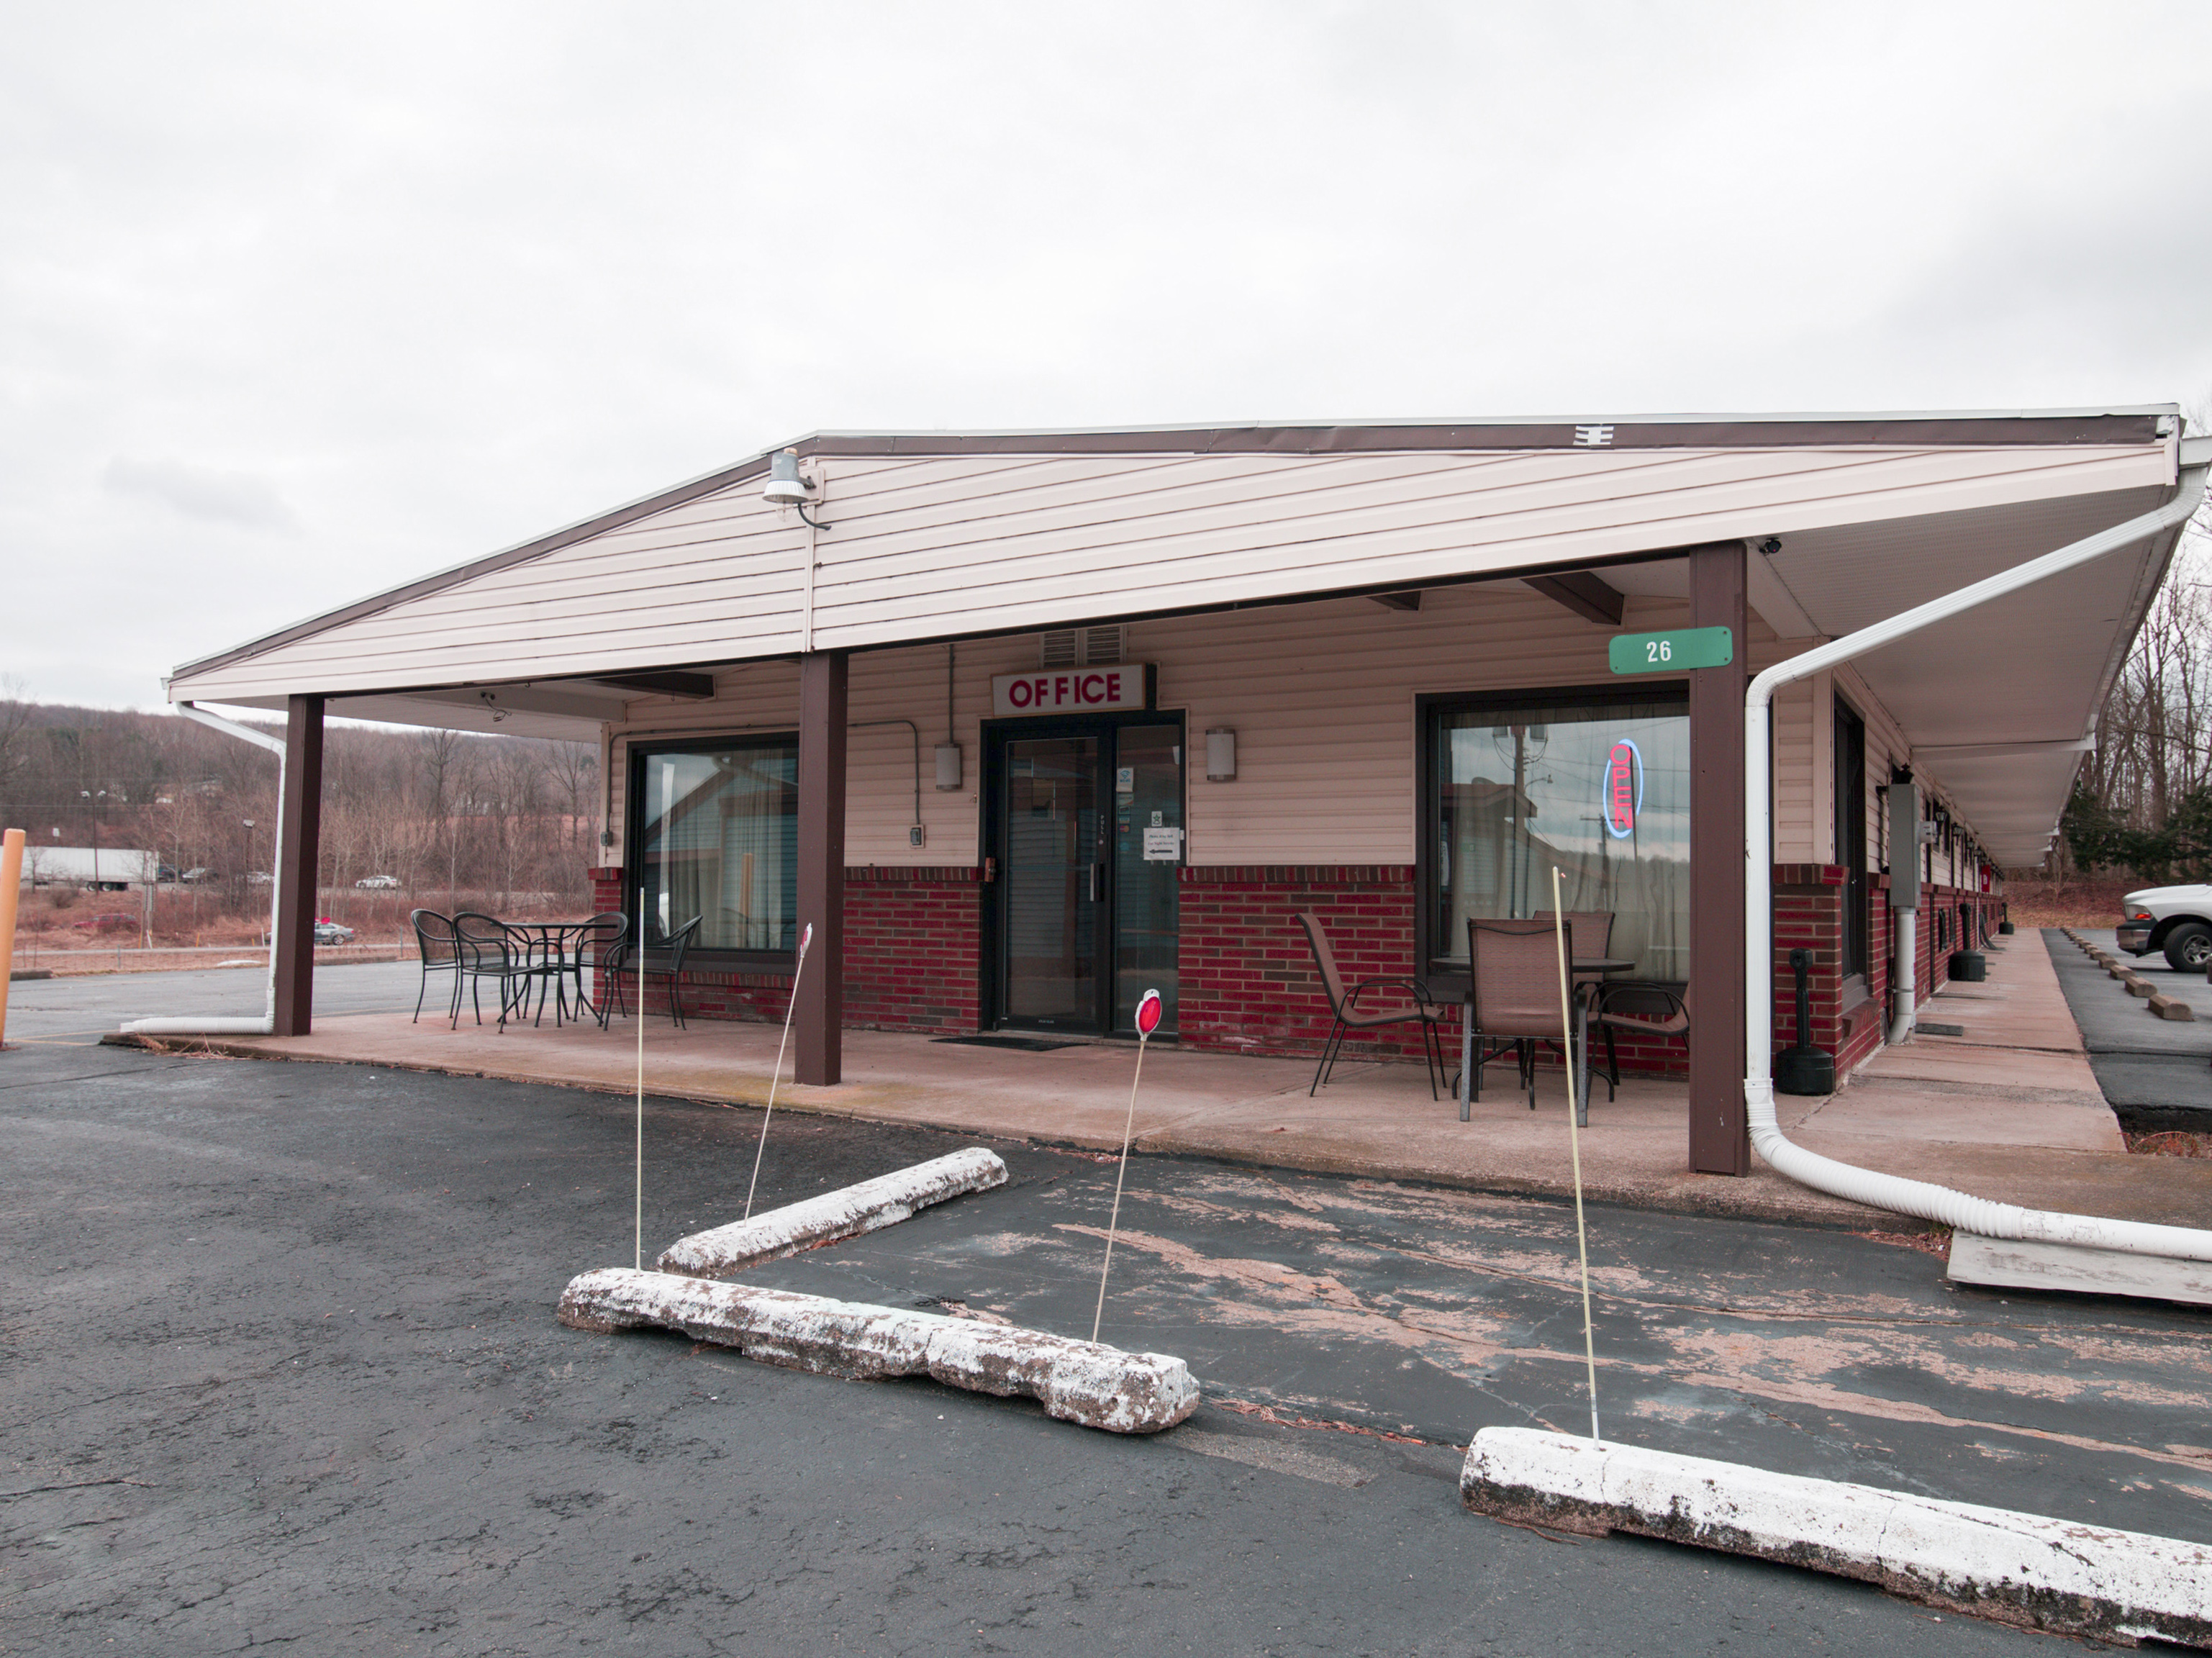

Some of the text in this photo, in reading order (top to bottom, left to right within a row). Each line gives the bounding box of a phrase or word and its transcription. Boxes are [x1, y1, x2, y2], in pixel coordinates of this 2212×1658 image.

[1646, 640, 1672, 663] 26
[1009, 673, 1120, 707] OFFICE
[1610, 744, 1633, 829] OPEN
